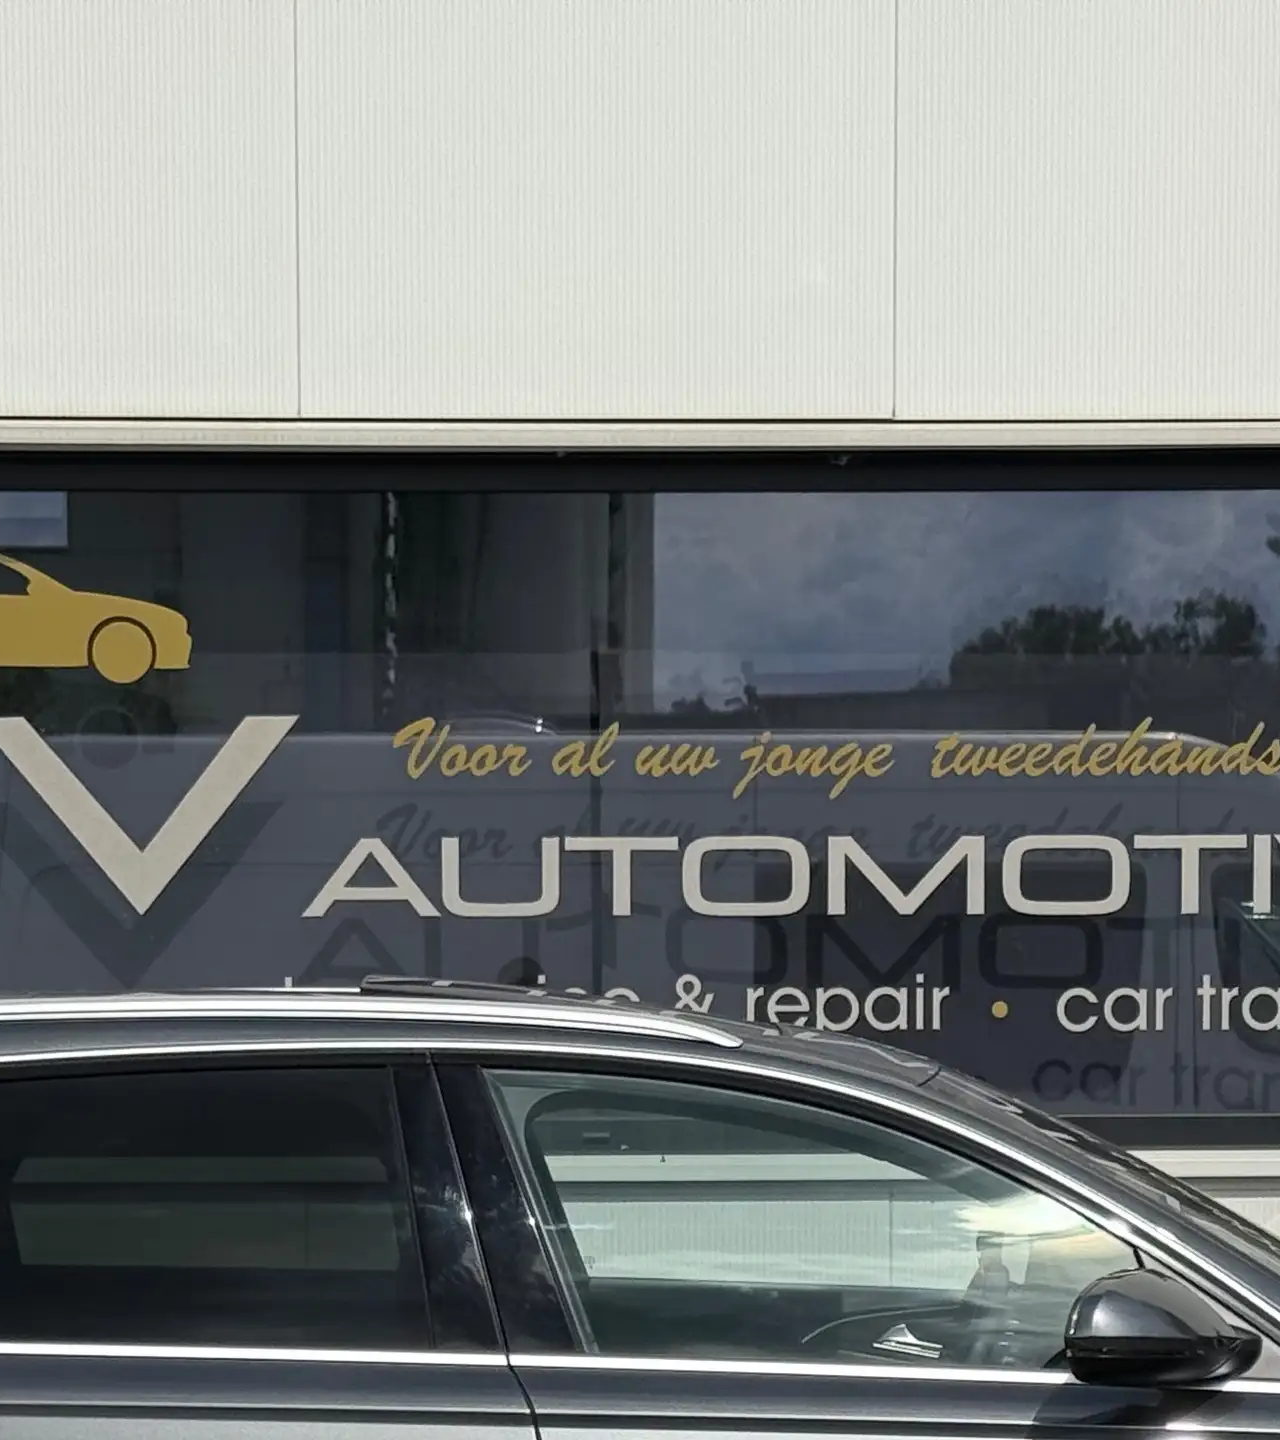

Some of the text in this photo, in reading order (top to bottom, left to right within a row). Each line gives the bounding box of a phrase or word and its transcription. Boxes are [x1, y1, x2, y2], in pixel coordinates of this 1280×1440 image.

[393, 717, 532, 780] Voor
[552, 722, 618, 777] al
[635, 744, 719, 777] uw
[732, 730, 894, 800] jonge
[746, 973, 950, 1032] repair
[1056, 983, 1173, 1032] car
